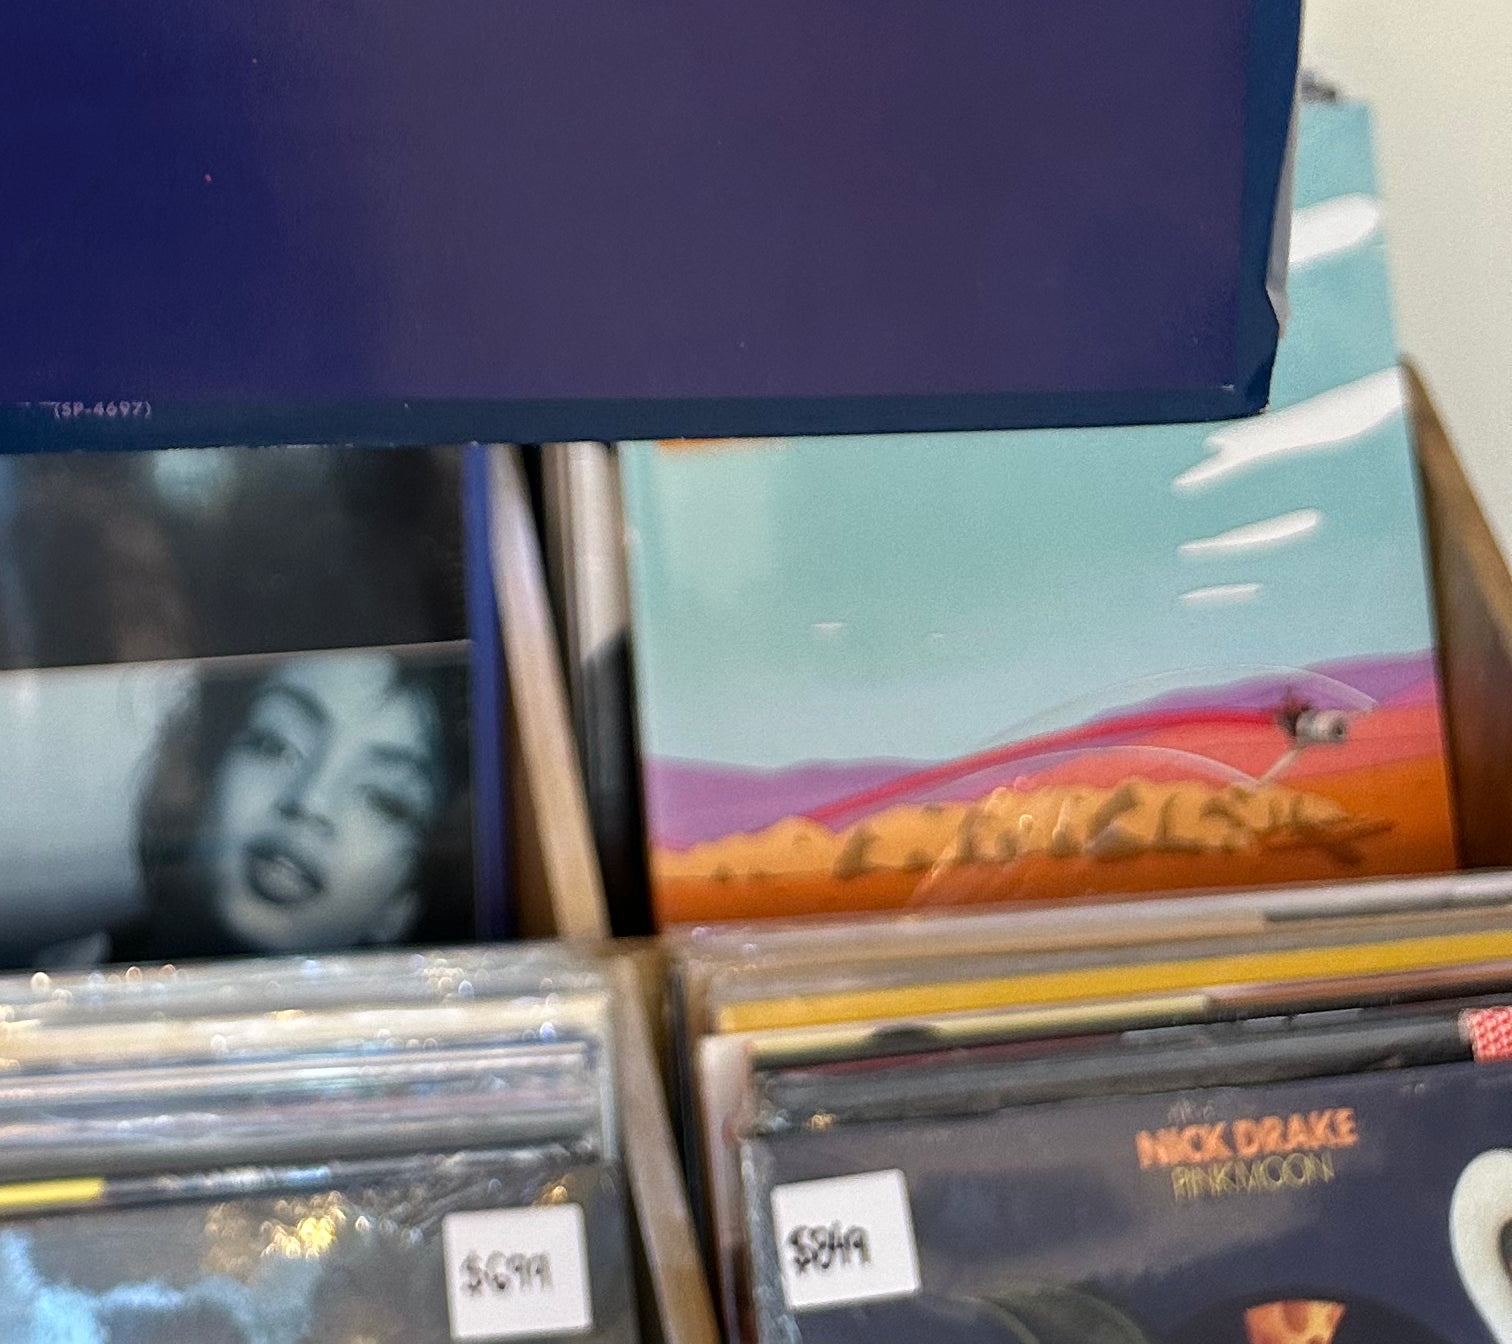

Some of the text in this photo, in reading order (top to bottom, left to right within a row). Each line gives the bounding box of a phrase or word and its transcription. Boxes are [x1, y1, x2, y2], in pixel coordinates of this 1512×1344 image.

[54, 401, 152, 419] (SP-4697)
[1135, 1121, 1234, 1170] NICK
[1232, 1107, 1359, 1160] DRAKE
[1171, 1150, 1335, 1202] PINK MOON
